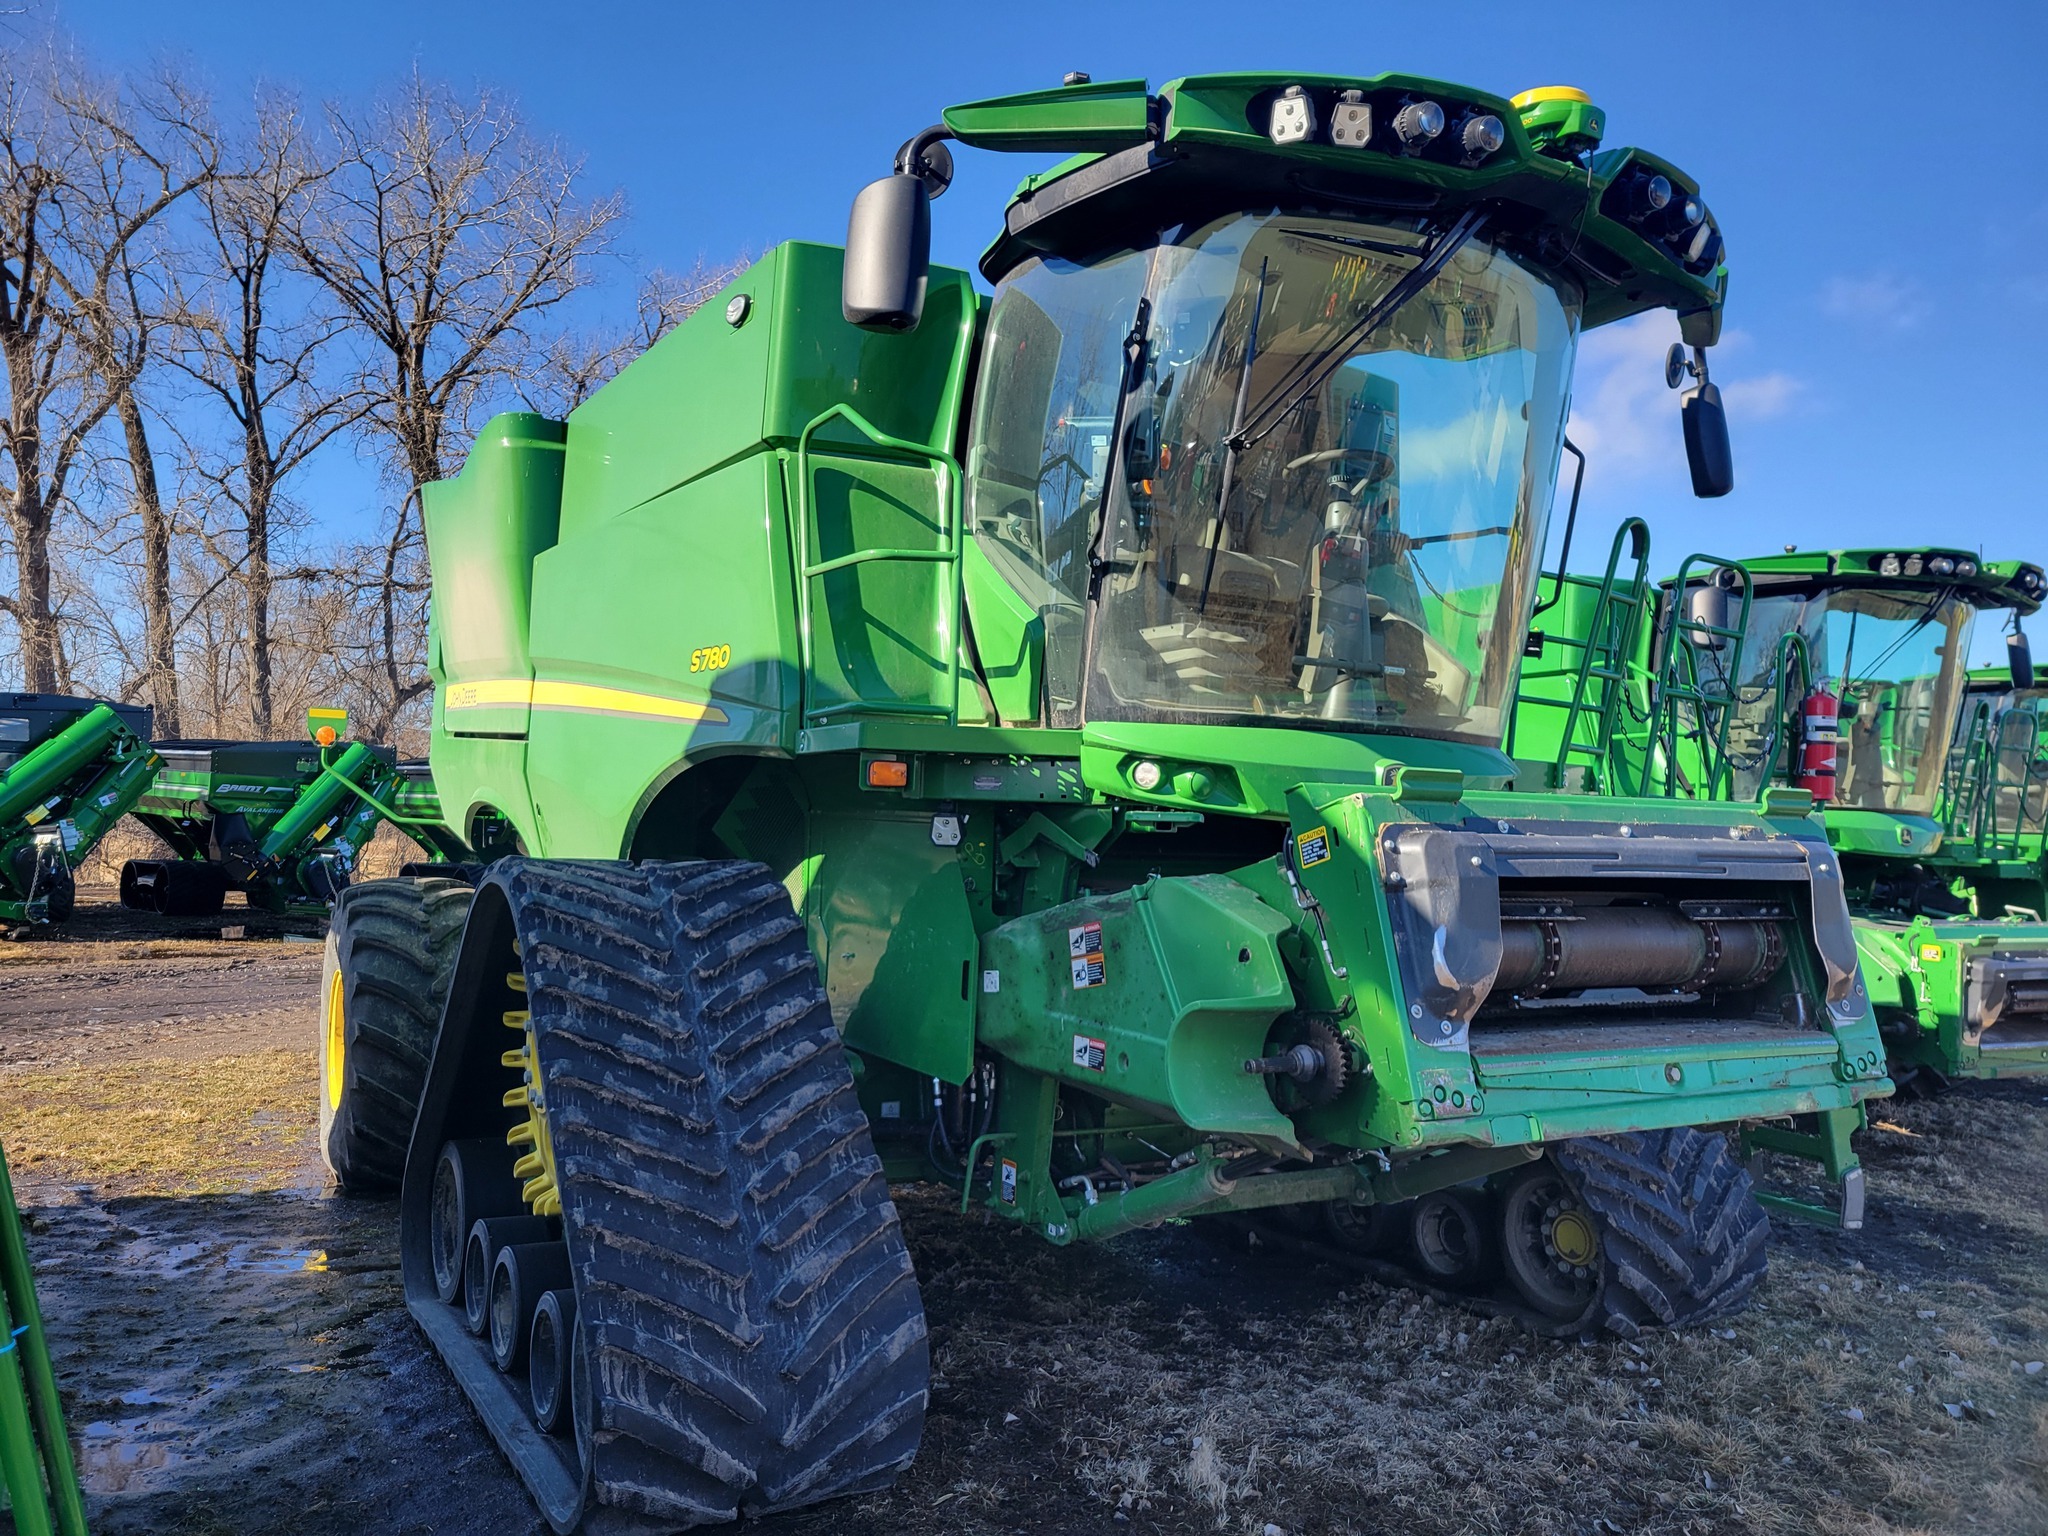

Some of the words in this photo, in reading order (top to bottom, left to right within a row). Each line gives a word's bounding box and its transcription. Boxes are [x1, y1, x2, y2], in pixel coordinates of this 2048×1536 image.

[690, 643, 731, 673] S780
[461, 688, 477, 706] DEERE
[236, 805, 285, 814] AVALANCHE
[1303, 828, 1326, 841] CAUTION
